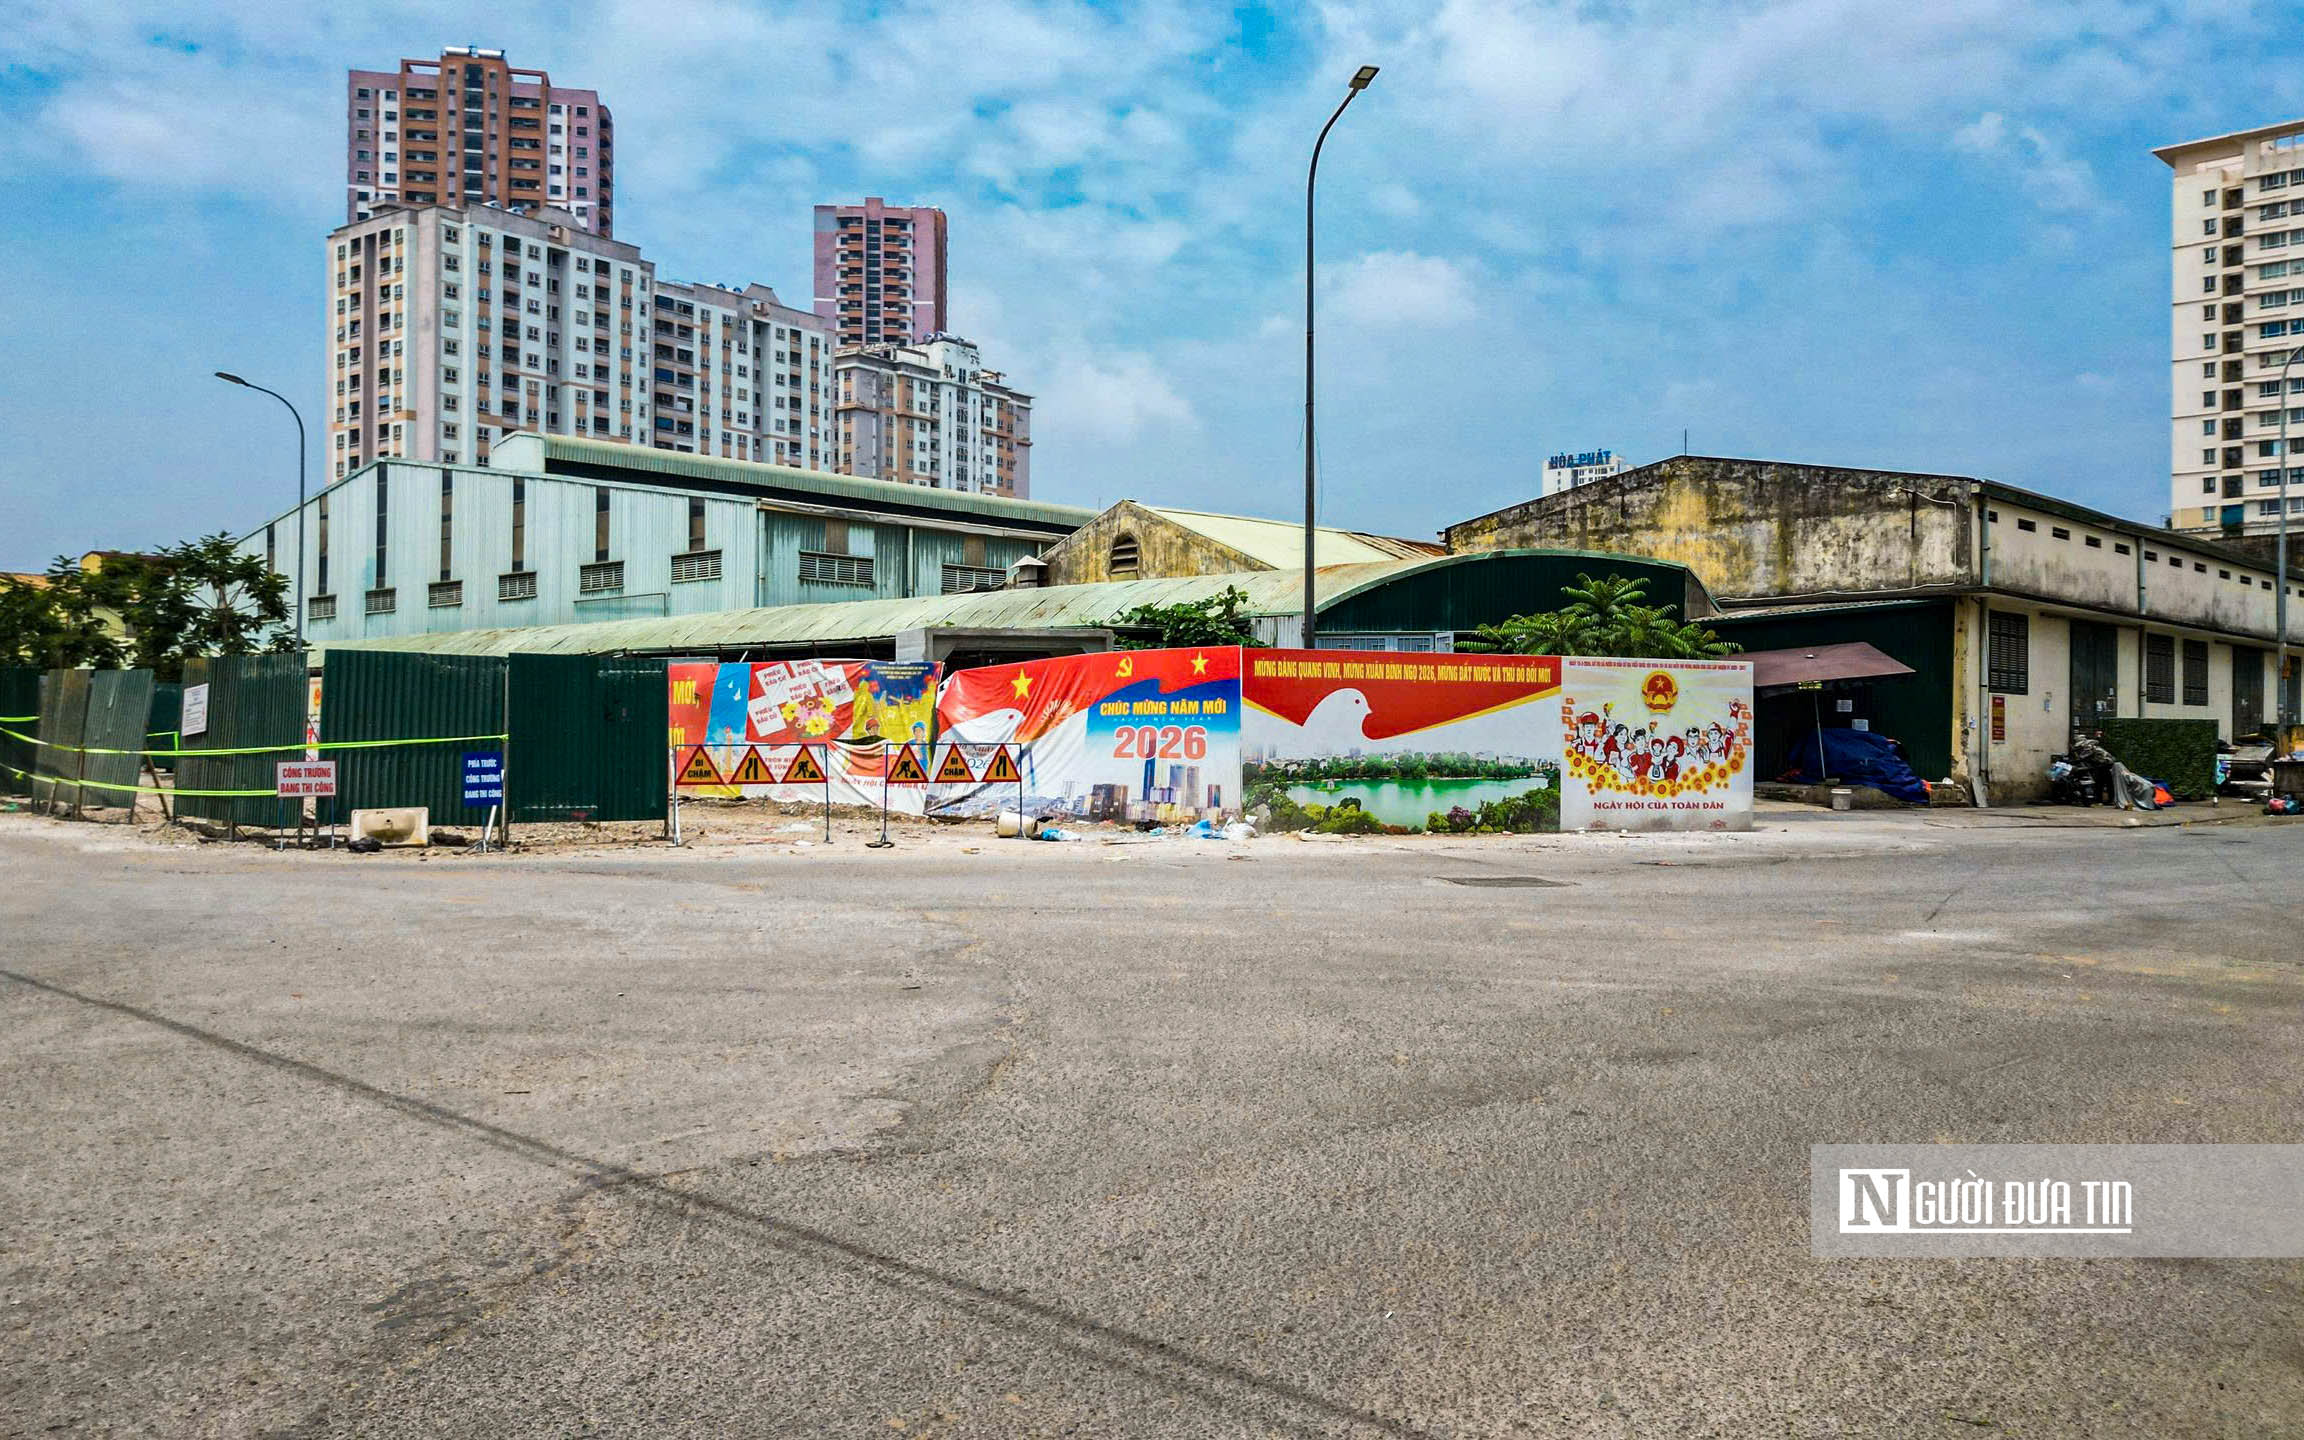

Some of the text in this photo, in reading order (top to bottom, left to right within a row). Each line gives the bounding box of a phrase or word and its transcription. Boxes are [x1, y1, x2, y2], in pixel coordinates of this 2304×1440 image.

[1549, 448, 1611, 469] HÒA PHÁT
[1254, 658, 1276, 677] MỪNG
[1278, 657, 1297, 677] ĐẢNG
[1299, 661, 1322, 680] QUANG
[1323, 661, 1342, 680] VINH,
[1343, 659, 1363, 679] MỪNG
[1366, 660, 1384, 679] XUÂN
[1403, 664, 1418, 683] NGỌ
[1418, 665, 1436, 683] 2026,
[1437, 662, 1458, 681] MỪNG
[1459, 661, 1472, 681] ĐẤT
[1473, 663, 1492, 682] NƯỚC
[1493, 664, 1501, 682] VÀ
[1502, 664, 1514, 682] THỦ
[1100, 697, 1227, 715] CHÚC MỪNG NĂM MỚI
[1113, 725, 1208, 760] 2026
[283, 766, 302, 778] CÔNG
[302, 782, 313, 793] THI
[314, 781, 334, 793] CÔNG
[1594, 799, 1724, 810] NGÀY HỘI CỦA TOÀN DÂN
